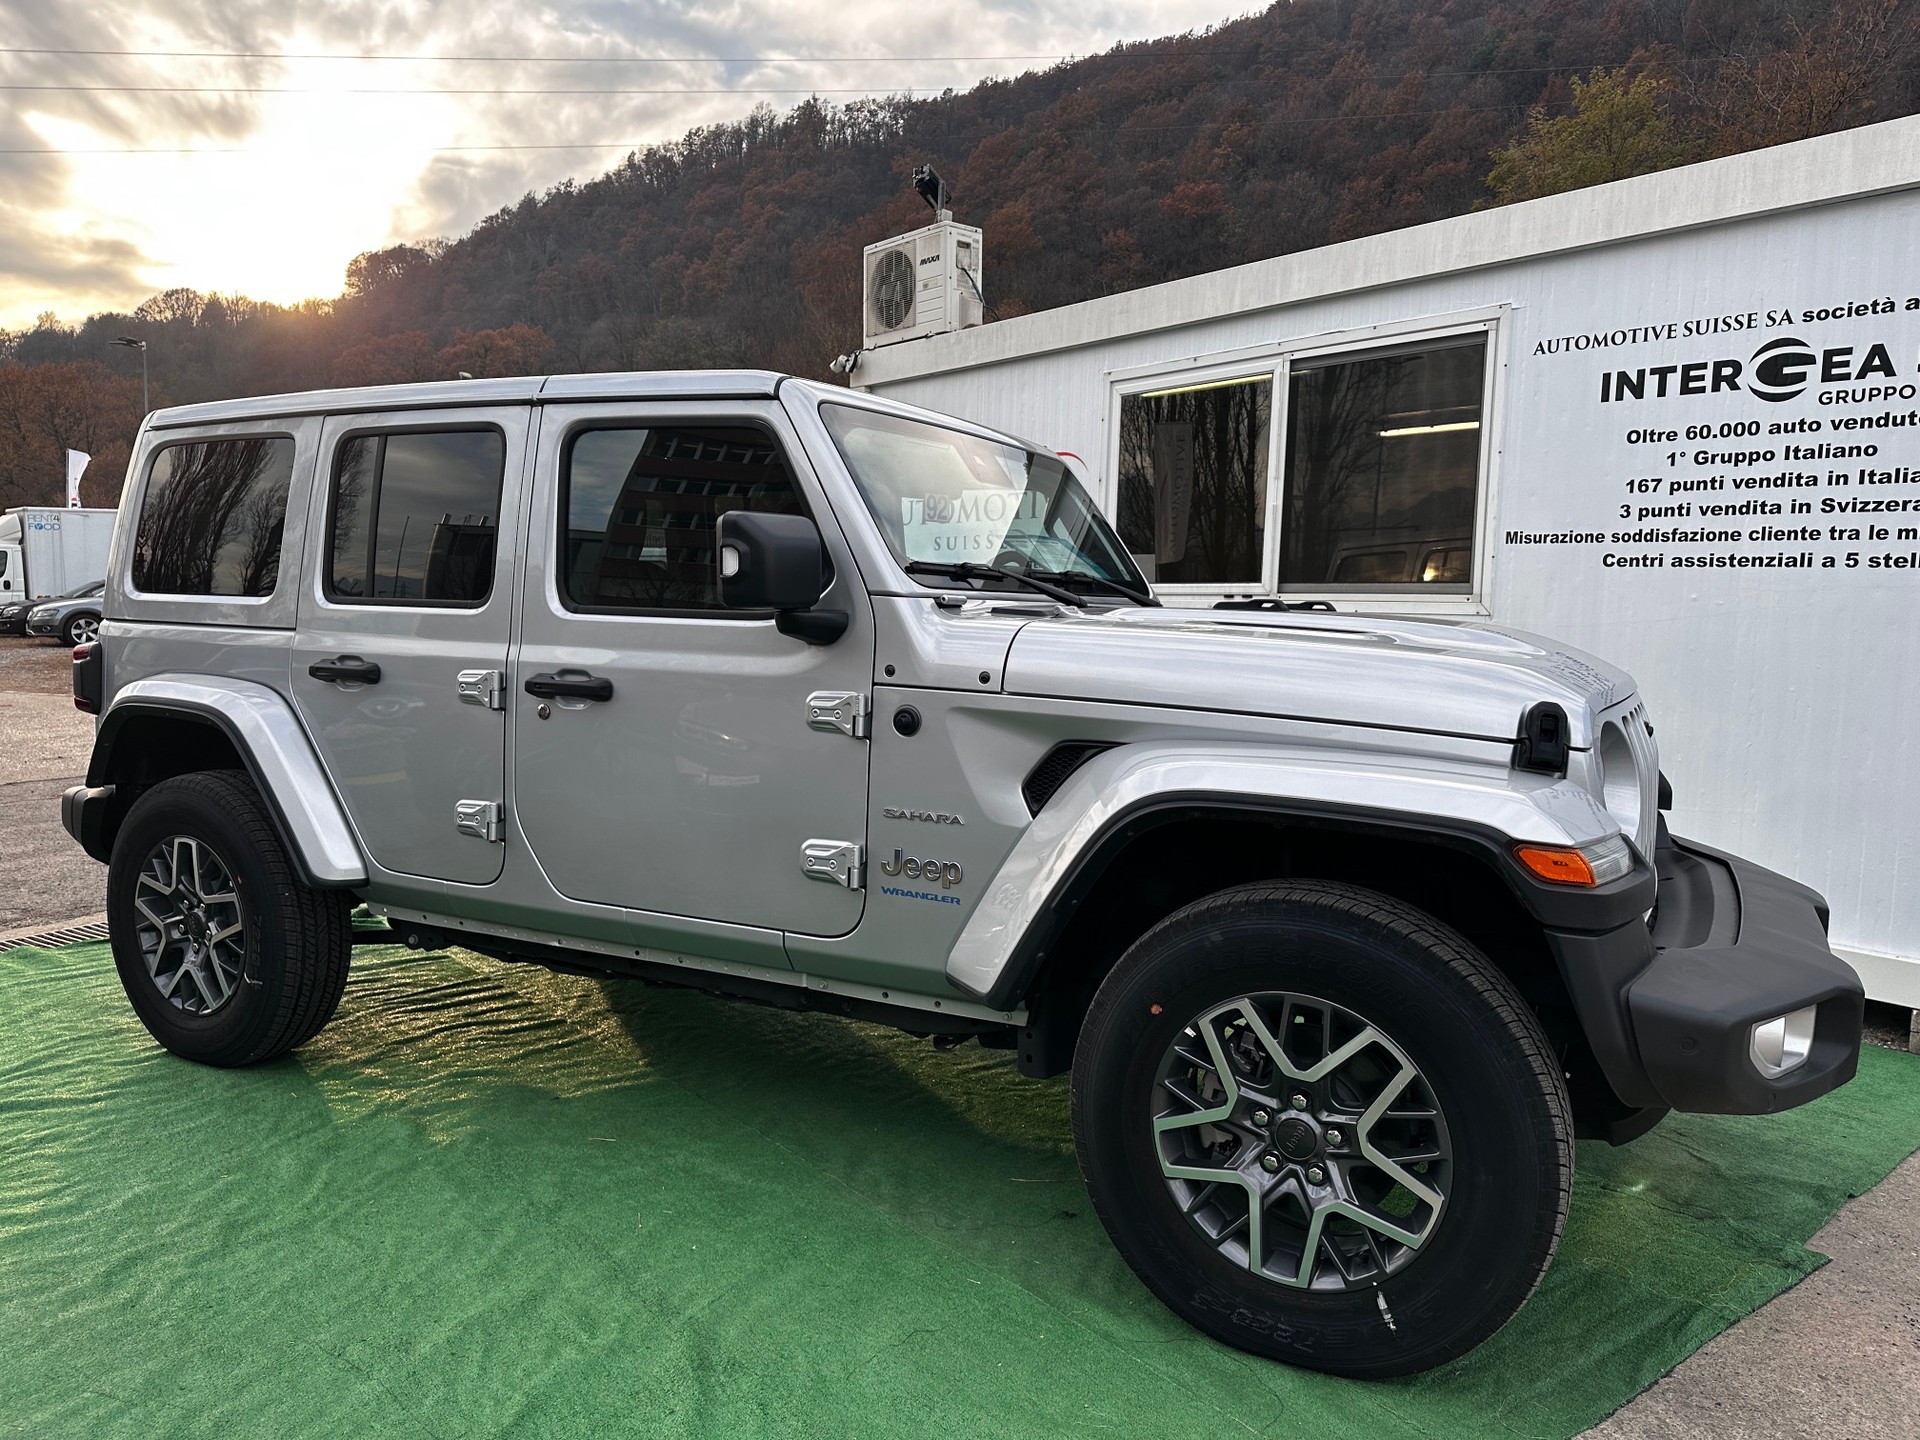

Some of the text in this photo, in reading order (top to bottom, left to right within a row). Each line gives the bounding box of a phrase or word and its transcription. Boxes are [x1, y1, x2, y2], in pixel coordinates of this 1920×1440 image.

[1533, 324, 1677, 355] AUTOMOTIVE
[1683, 313, 1757, 337] SUISSE
[1766, 309, 1794, 327] SA
[1802, 297, 1895, 322] società
[1819, 385, 1916, 405] GRUPPO
[1627, 429, 1678, 444] Oltre
[1686, 421, 1760, 440] 60.000
[1769, 418, 1821, 434] auto
[1667, 443, 1878, 467] 1° Gruppo Italiano
[1626, 468, 1920, 495] 167 punti vendita in Italia
[1620, 505, 1630, 518] 3
[1638, 503, 1691, 521] punti
[1699, 500, 1781, 516] vendita
[1791, 499, 1811, 513] in
[1506, 525, 1920, 544] Misurazione soddisfazione cliente tra le m
[1603, 554, 1663, 567] Centri
[1671, 553, 1813, 567] assistenziali
[1822, 556, 1835, 568] a
[1845, 553, 1859, 568] 5
[883, 807, 965, 825] SAHARA
[881, 847, 963, 889] Jeep
[881, 886, 961, 905] WRANGLER
